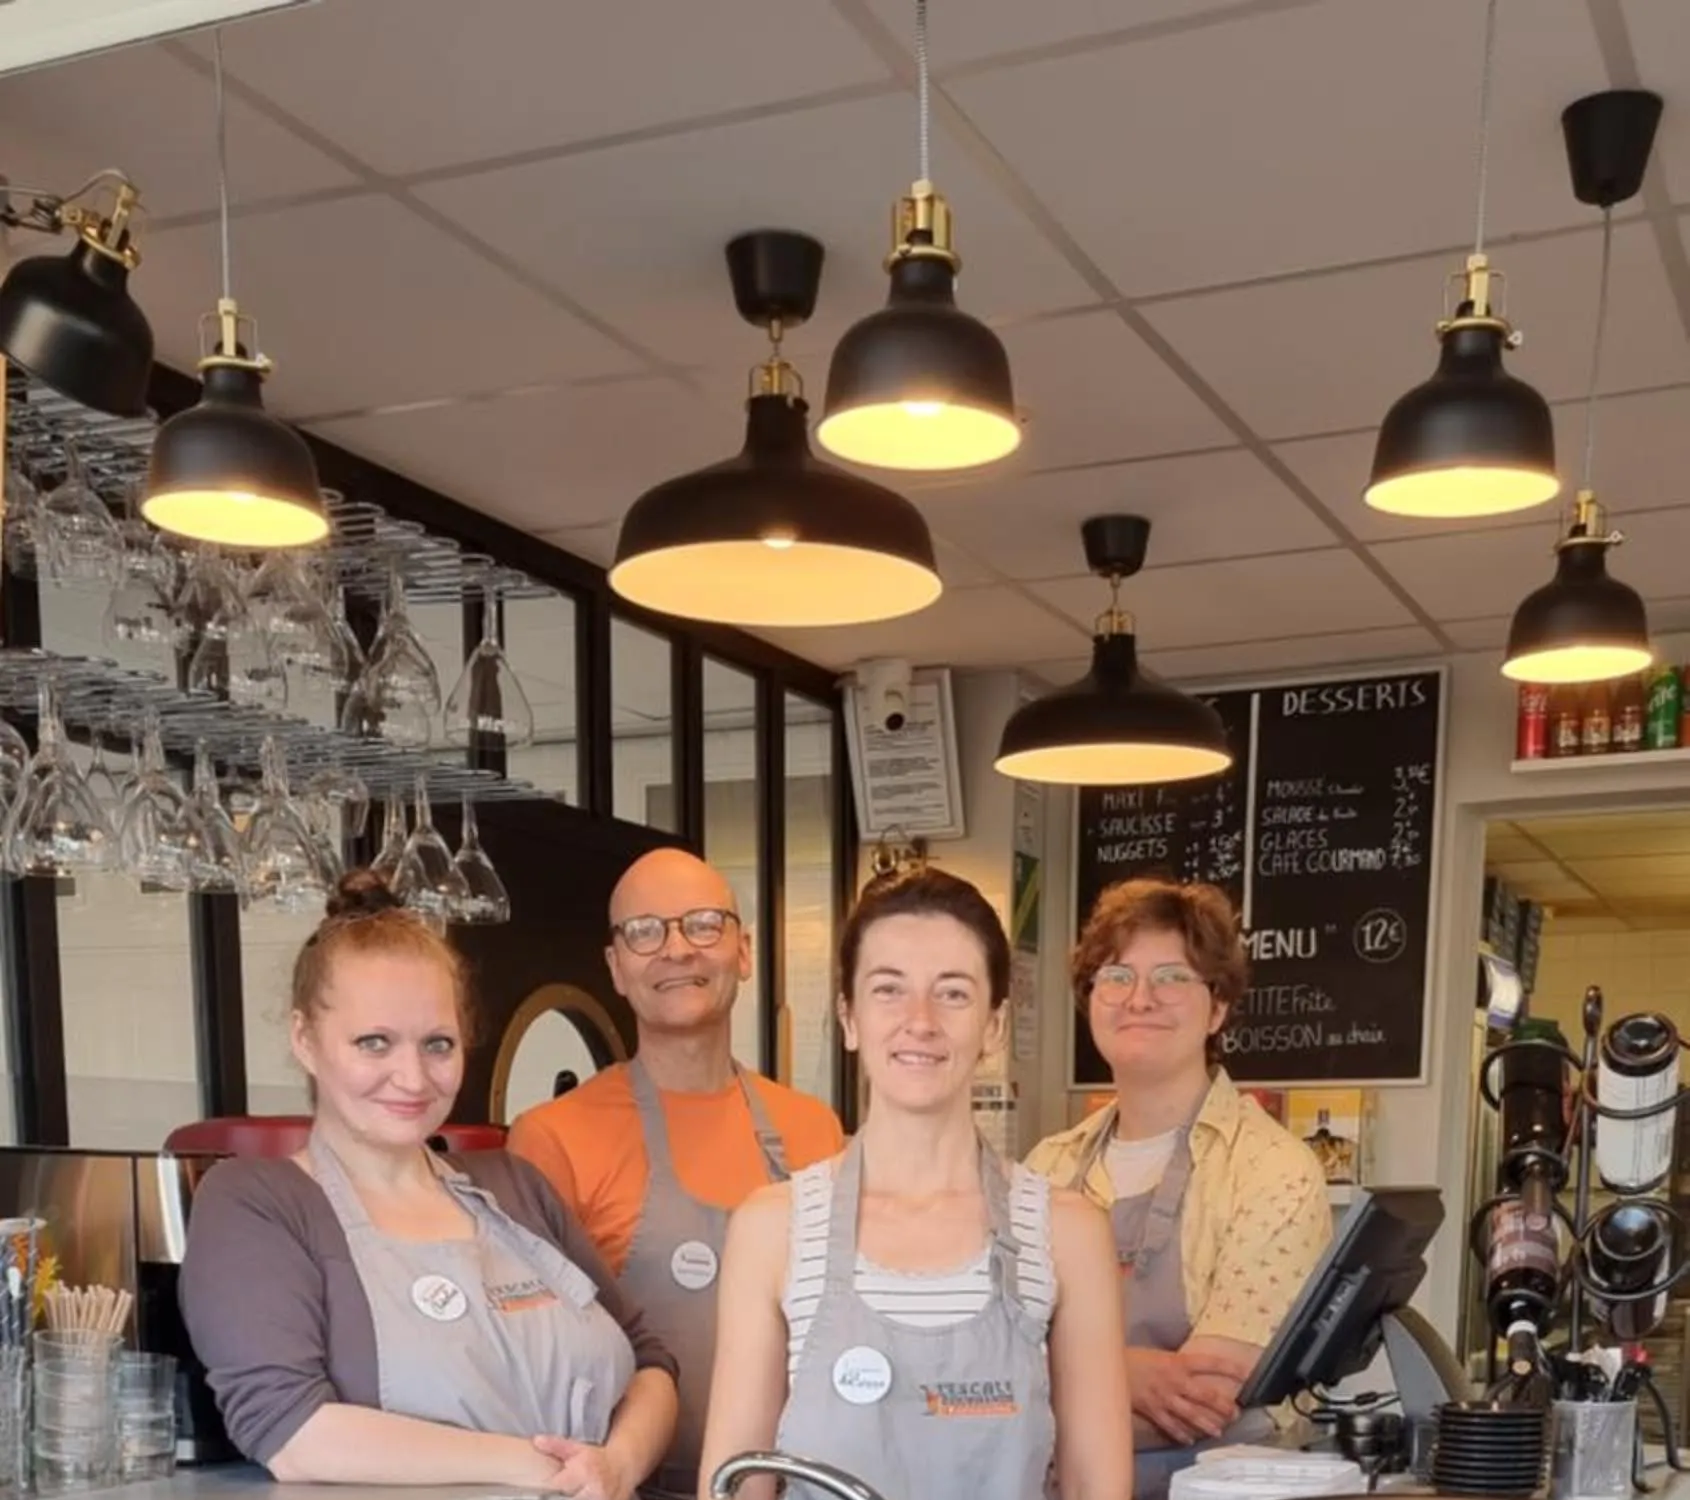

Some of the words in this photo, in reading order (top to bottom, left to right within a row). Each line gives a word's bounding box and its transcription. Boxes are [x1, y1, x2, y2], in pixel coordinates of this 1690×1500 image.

[1283, 679, 1426, 717] DESSERTS
[1100, 812, 1177, 839] SAUCISSE
[1097, 837, 1169, 863] NUGGETS
[1260, 828, 1328, 852] GLACES
[1238, 927, 1318, 961] MENU
[1361, 917, 1402, 952] 12€
